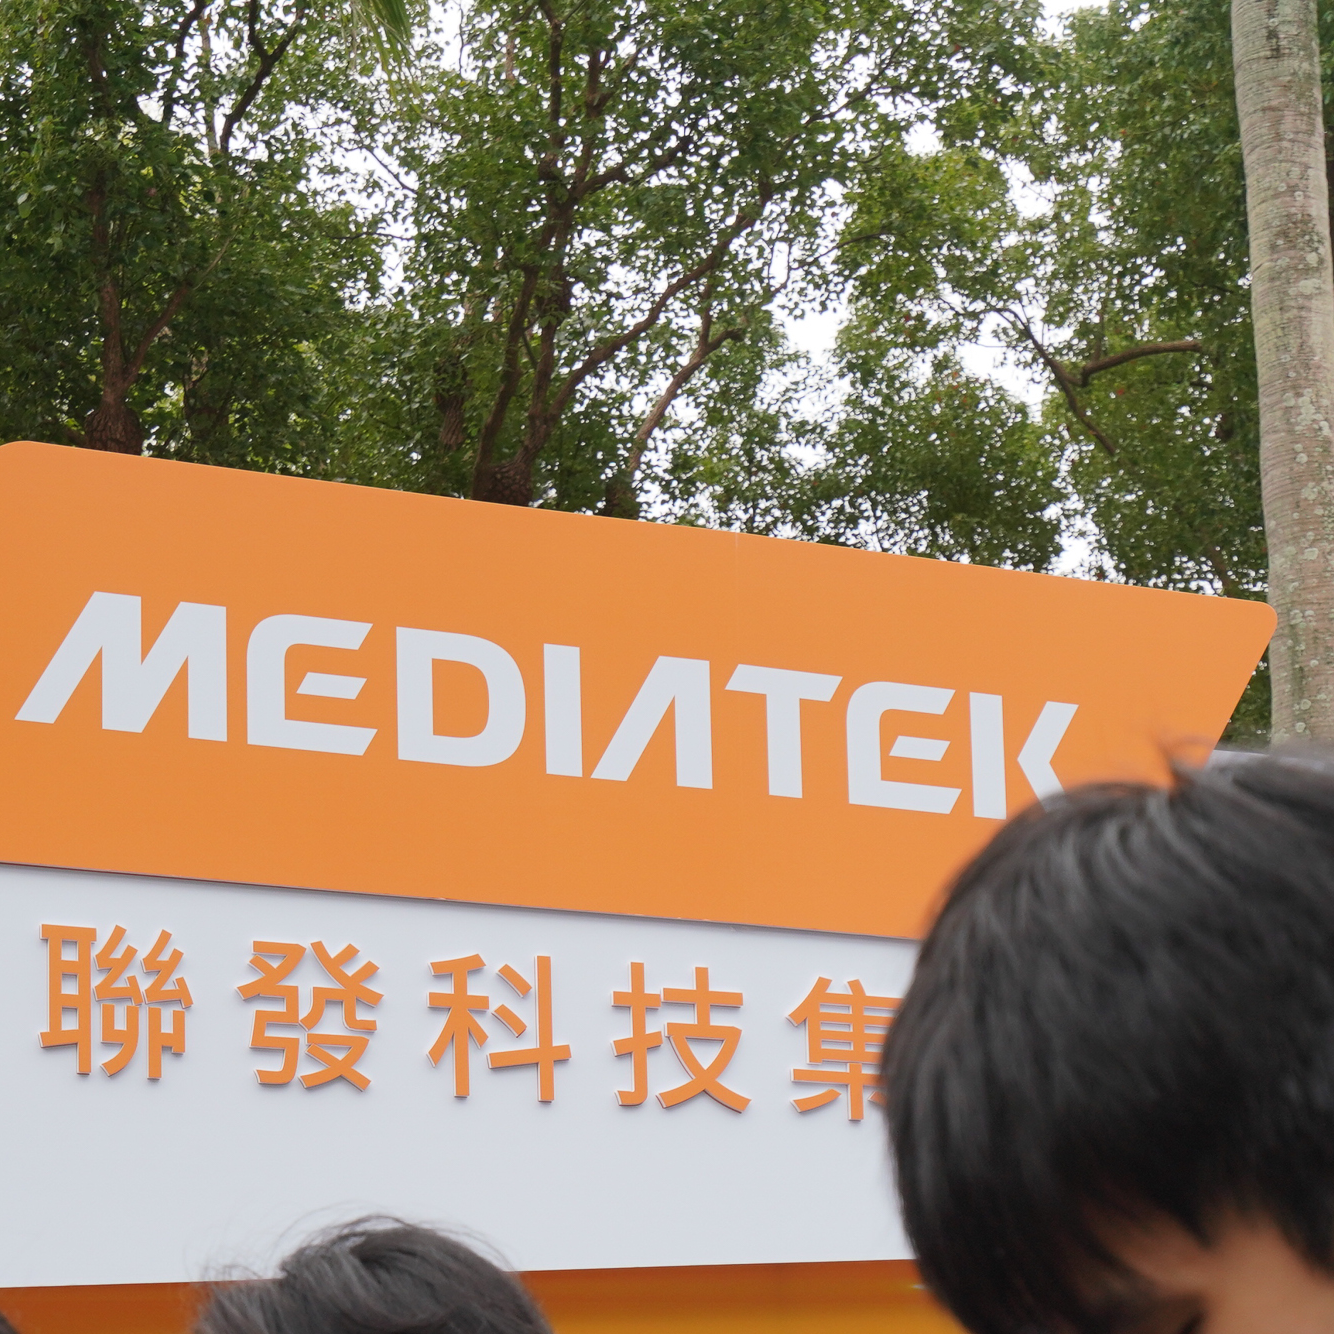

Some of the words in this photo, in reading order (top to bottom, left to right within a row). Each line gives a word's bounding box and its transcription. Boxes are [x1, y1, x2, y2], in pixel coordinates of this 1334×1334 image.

[15, 591, 1079, 820] MEDIATEK
[39, 922, 904, 1121] 聯發科技集
